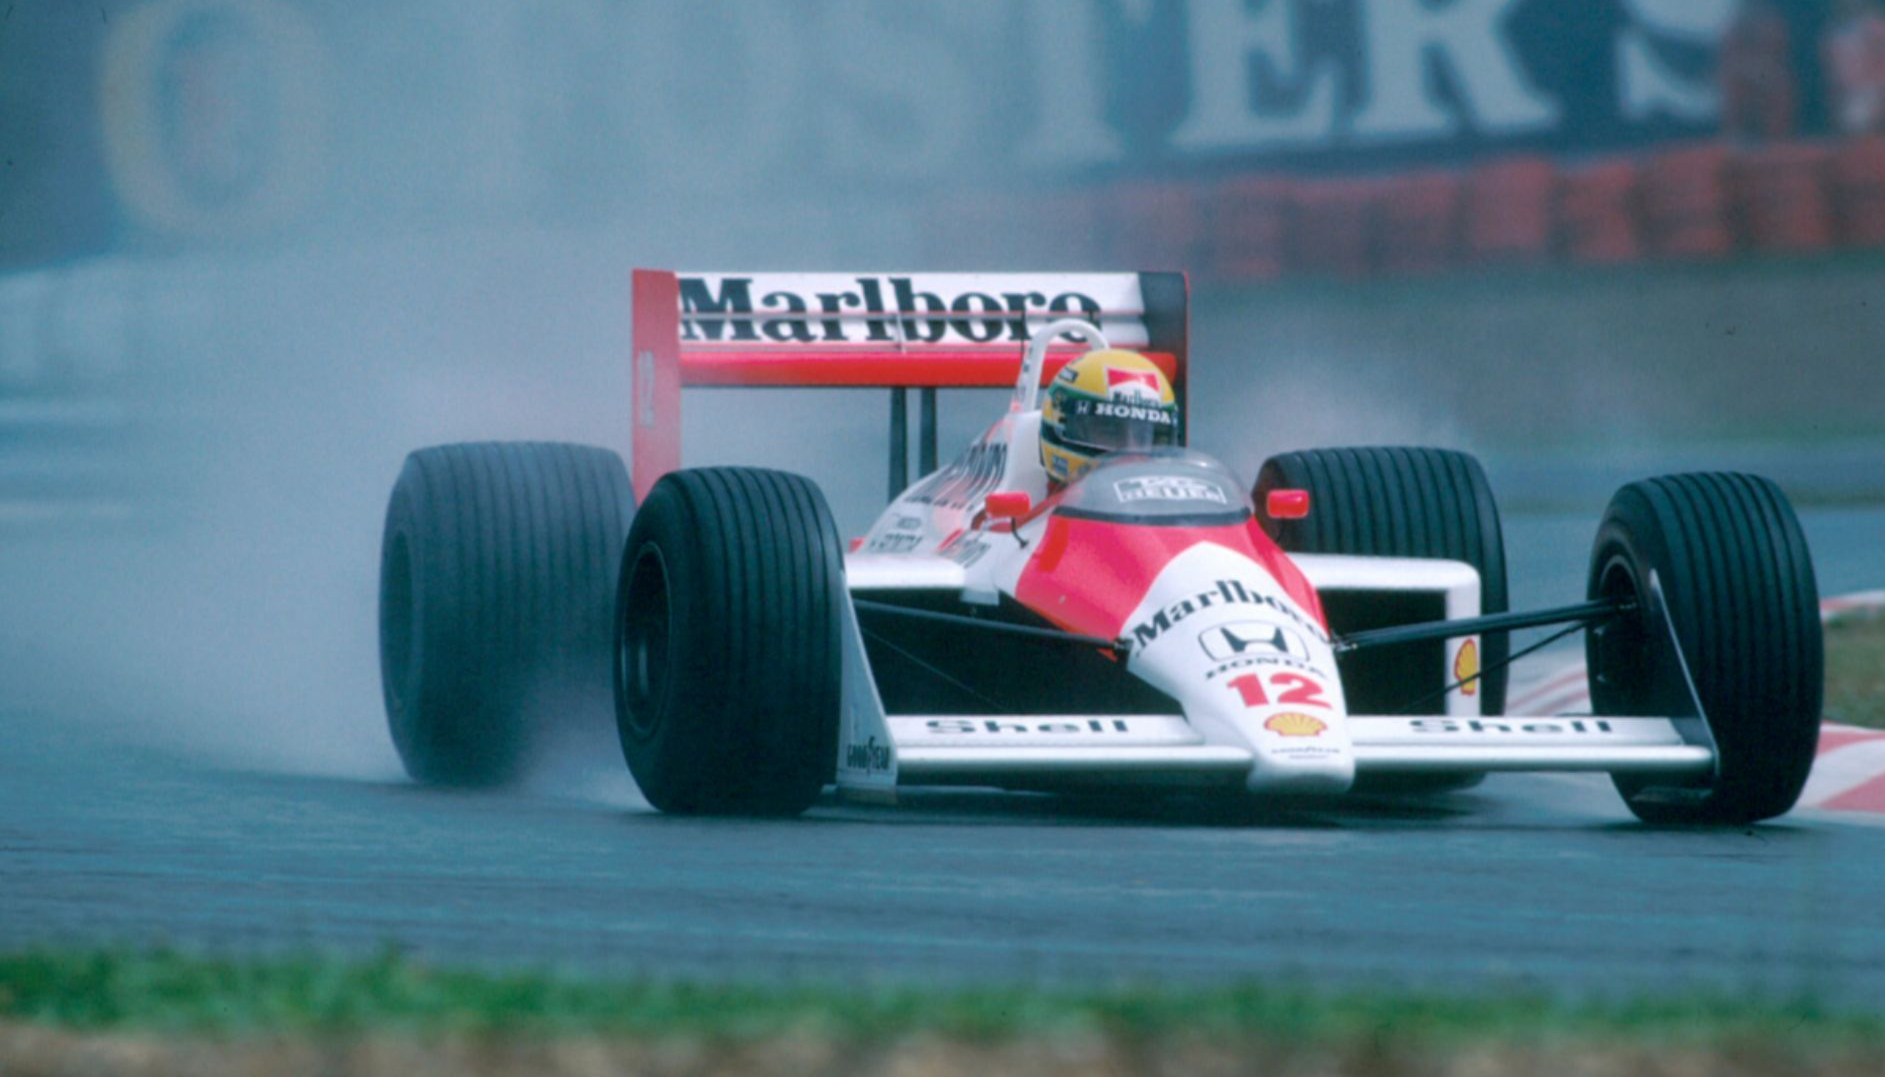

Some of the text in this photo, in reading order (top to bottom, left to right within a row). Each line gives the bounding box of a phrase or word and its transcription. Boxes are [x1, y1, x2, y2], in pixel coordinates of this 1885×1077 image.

[678, 276, 1101, 343] Marlboro
[1095, 403, 1171, 425] HONDA
[1131, 579, 1330, 652] Marlboro
[1205, 656, 1328, 681] HONDA
[1226, 671, 1333, 710] 12
[925, 719, 1129, 734] Shell
[1409, 719, 1613, 733] Shell
